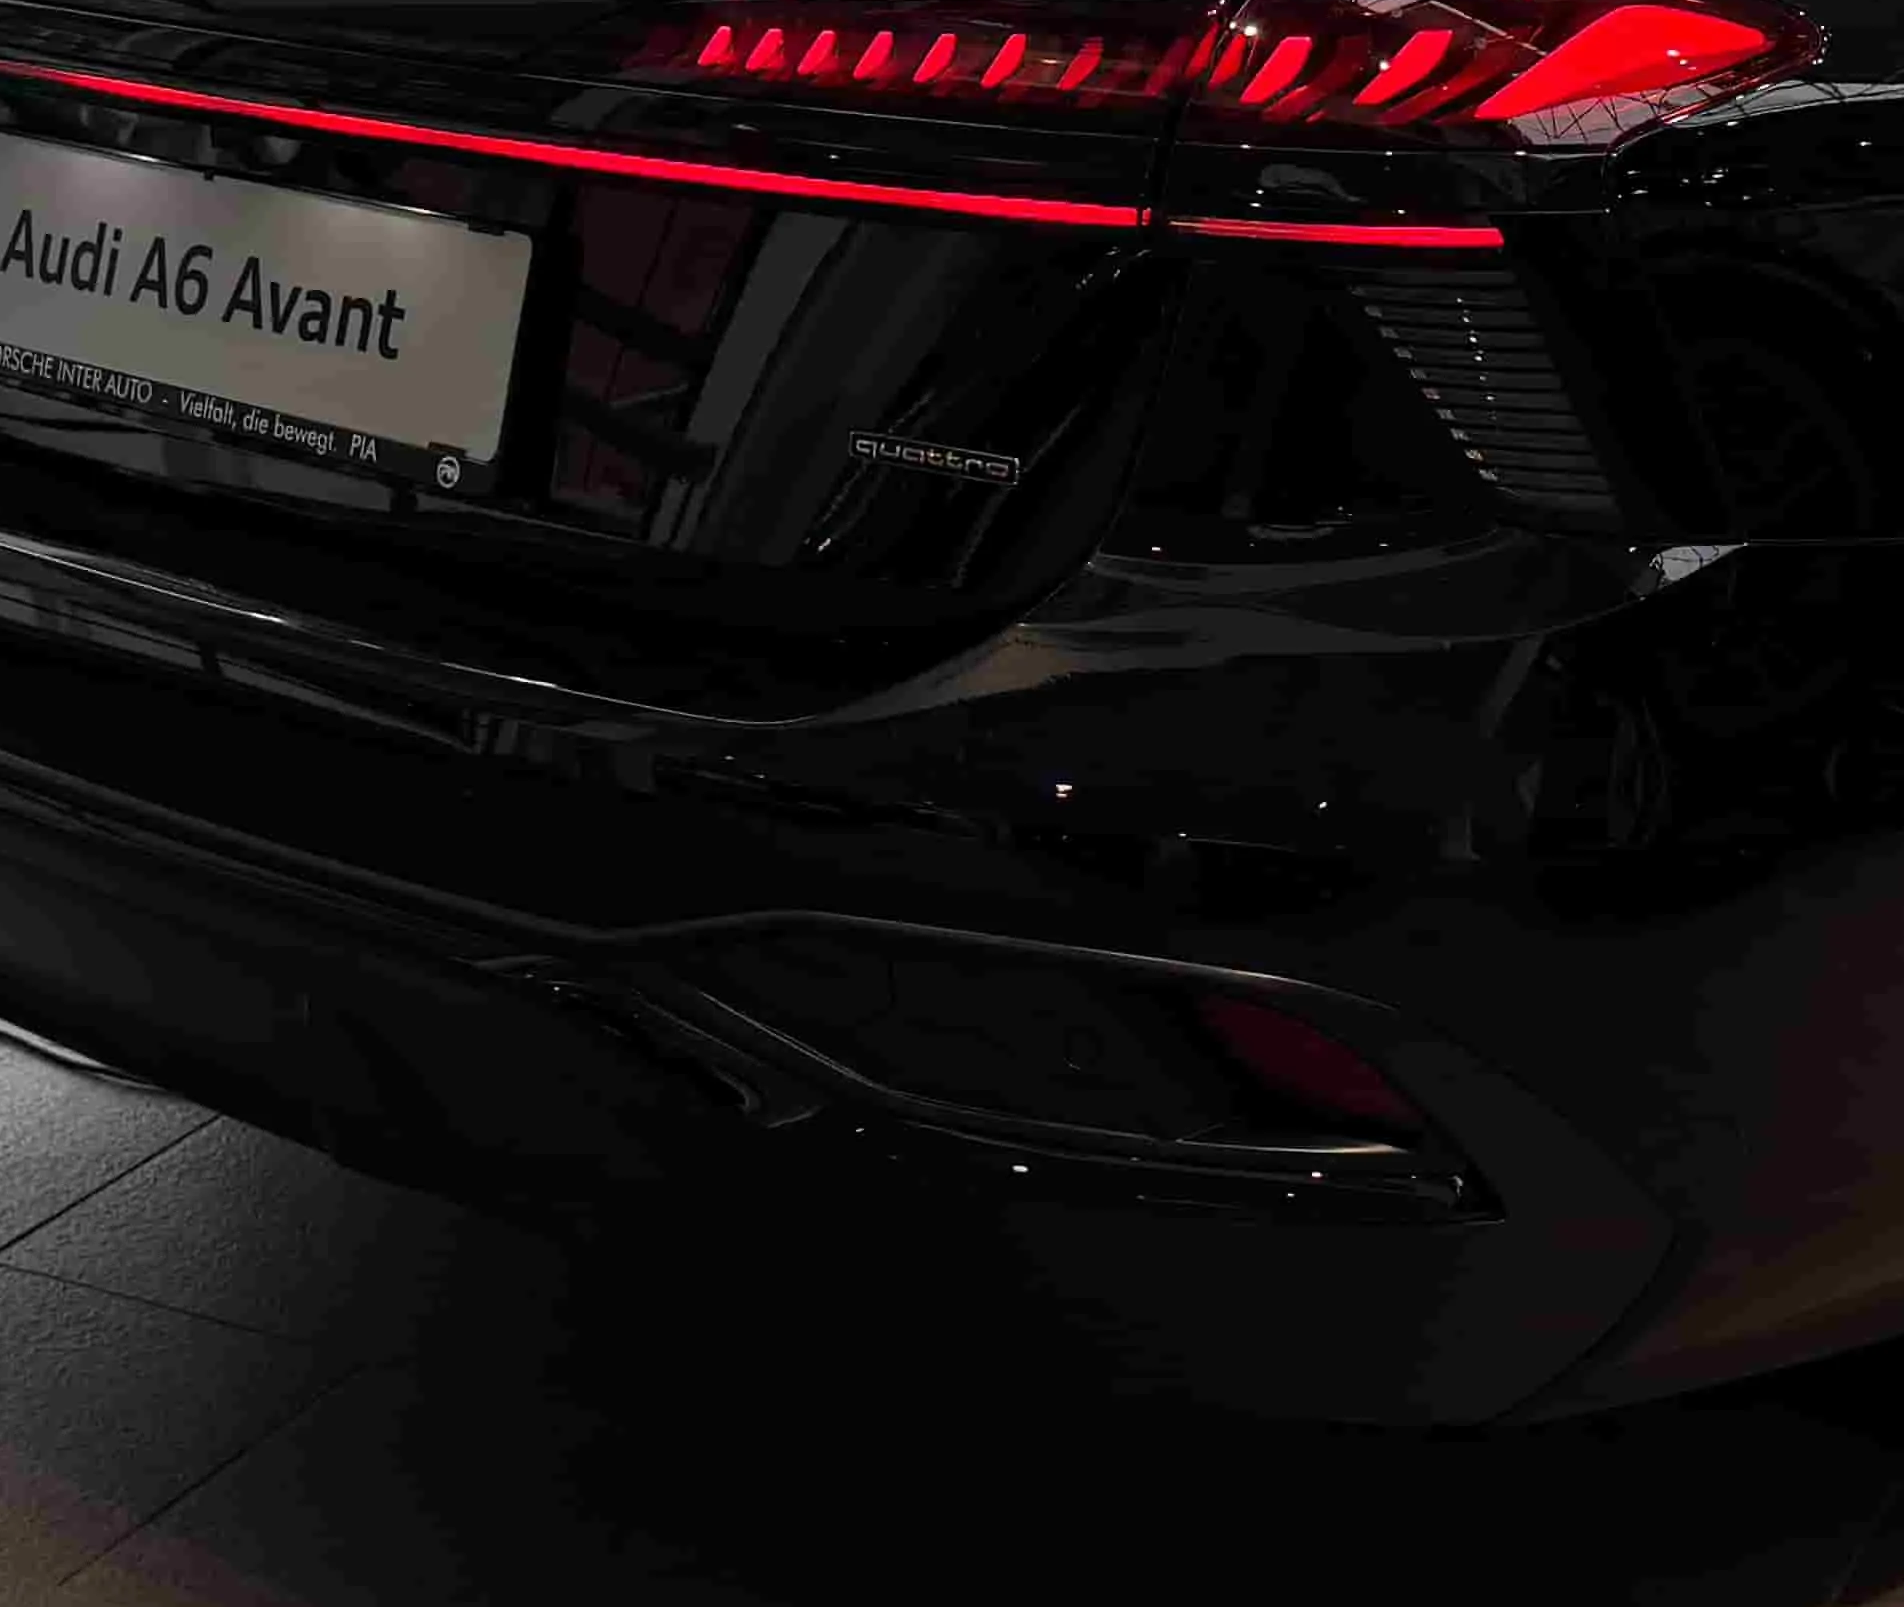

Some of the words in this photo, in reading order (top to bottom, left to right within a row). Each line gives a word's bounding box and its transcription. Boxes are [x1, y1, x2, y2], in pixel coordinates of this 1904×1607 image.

[0, 209, 123, 297] Audi
[129, 236, 214, 315] A6
[221, 256, 406, 360] Avant
[57, 360, 102, 392] INTER
[104, 374, 153, 403] AUTO
[179, 391, 236, 430] Vielfalt,
[243, 409, 268, 435] die
[349, 434, 378, 463] PIA
[855, 439, 1009, 477] quattro
